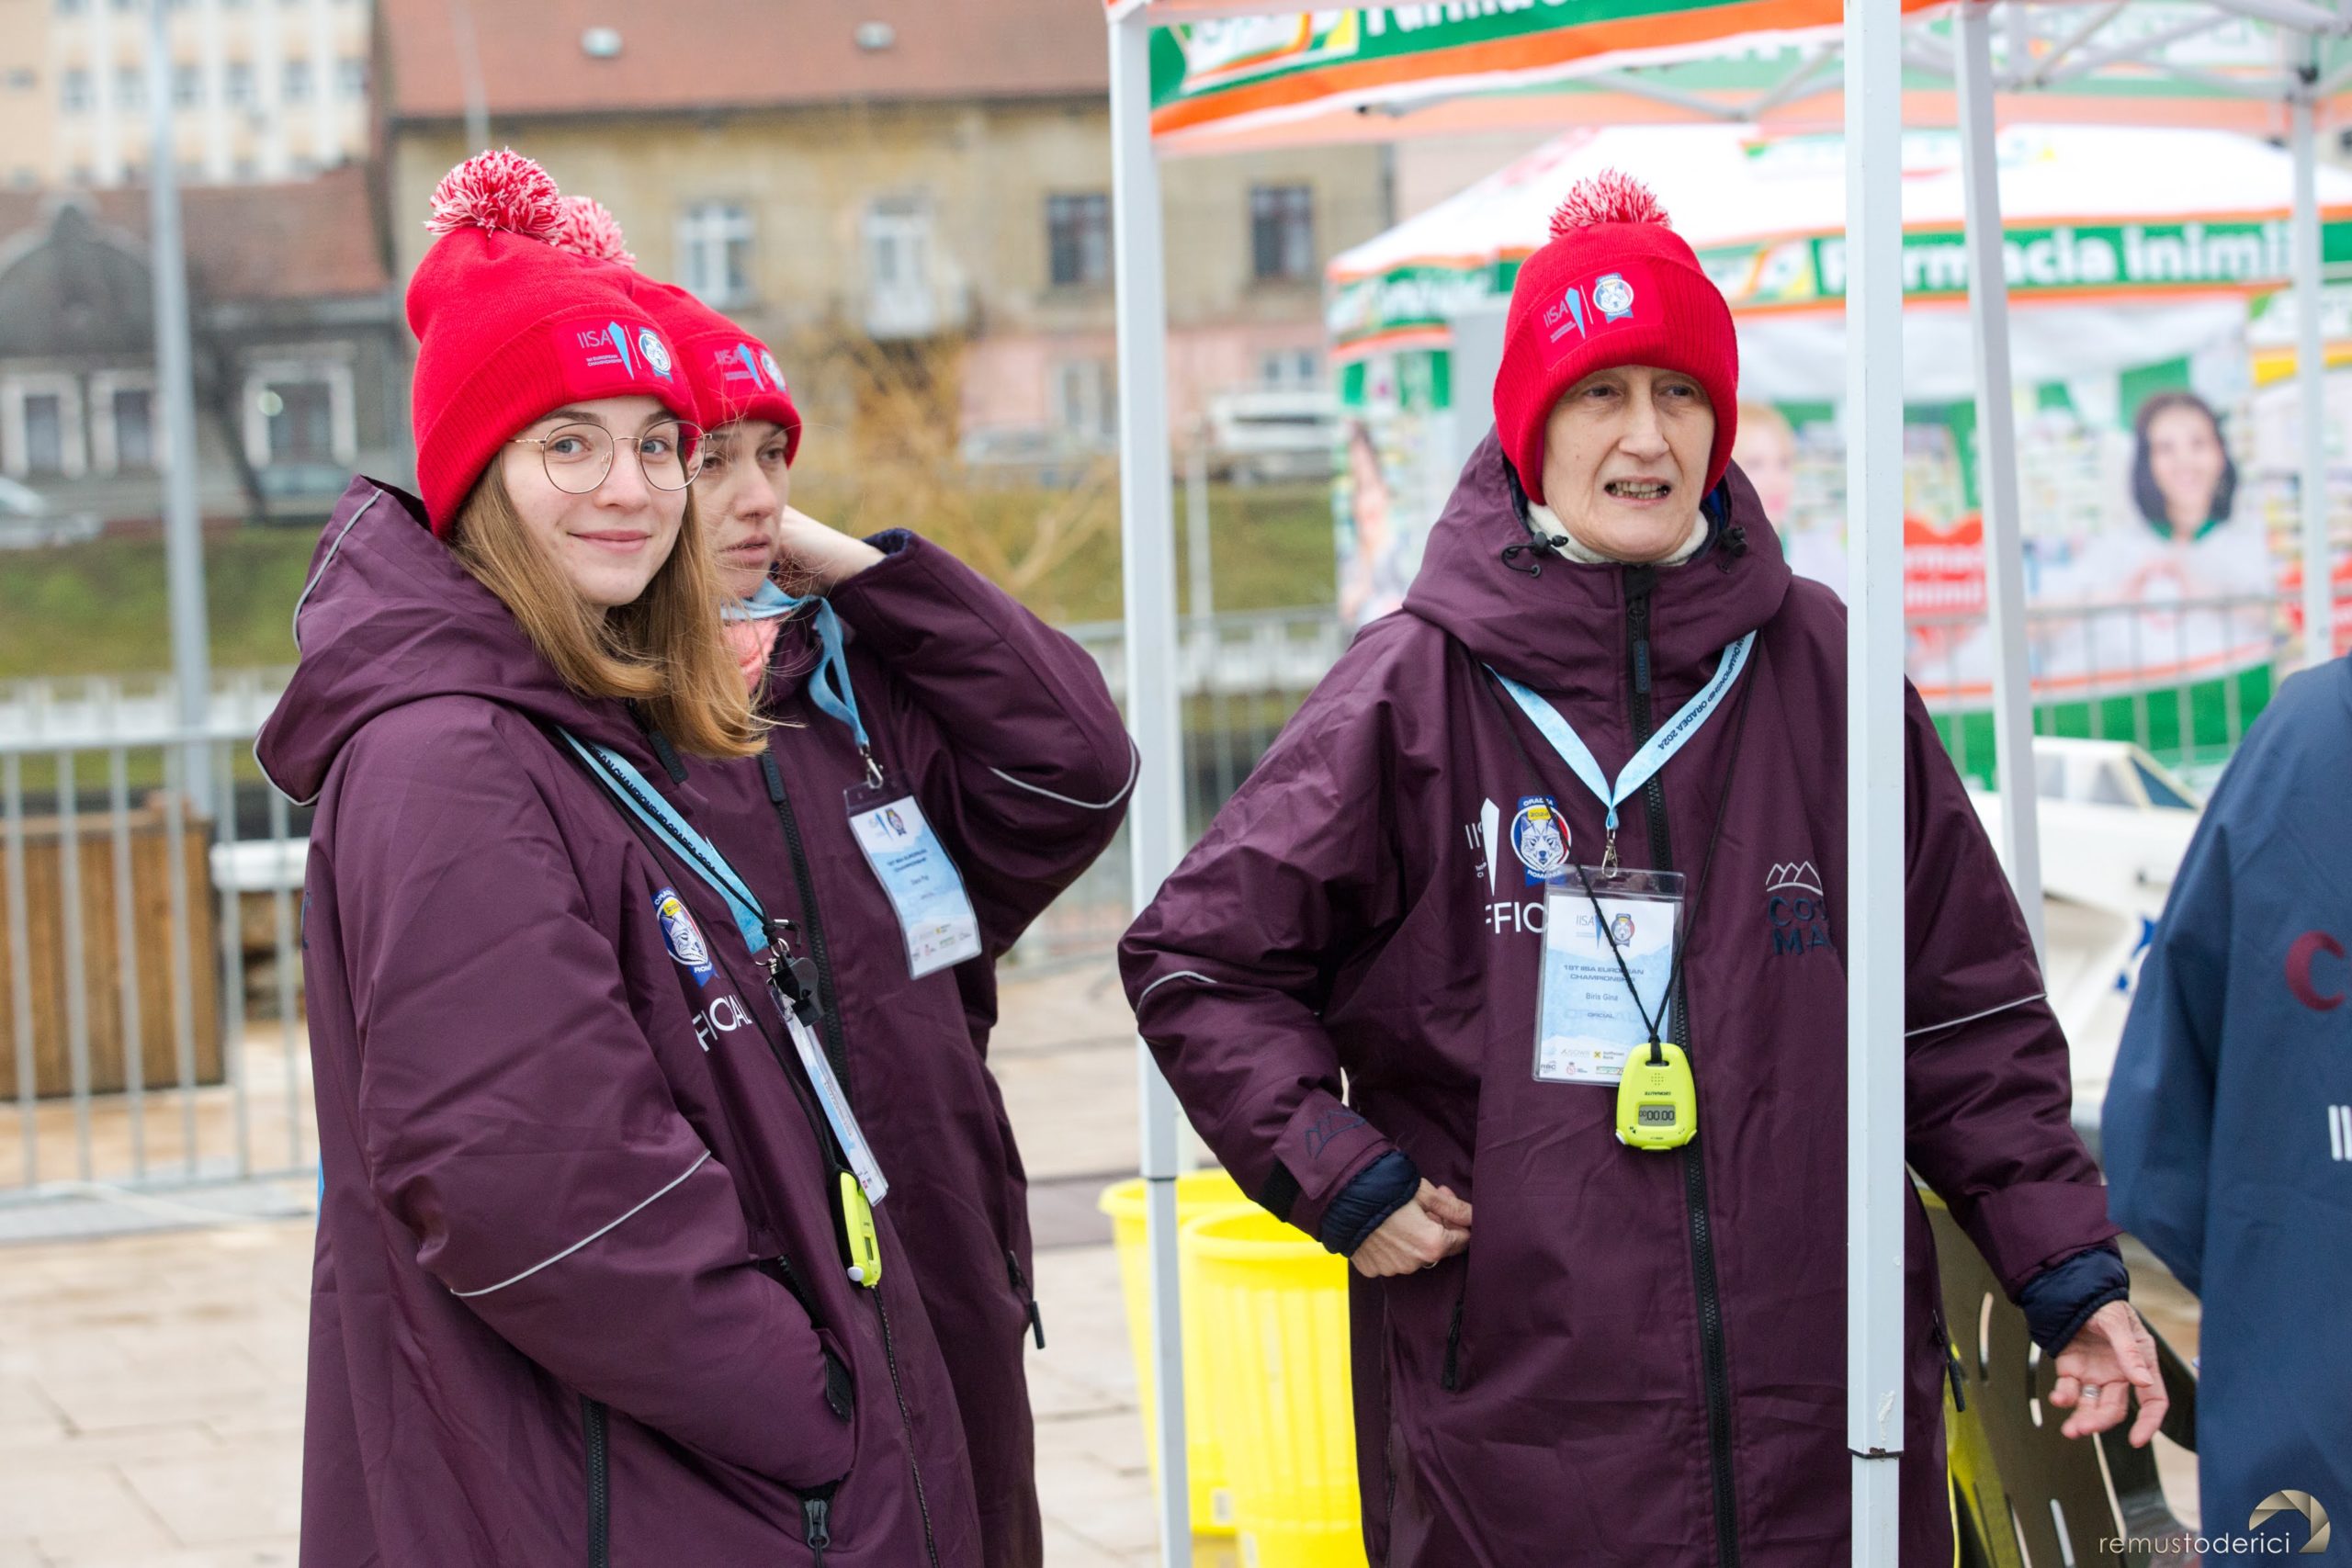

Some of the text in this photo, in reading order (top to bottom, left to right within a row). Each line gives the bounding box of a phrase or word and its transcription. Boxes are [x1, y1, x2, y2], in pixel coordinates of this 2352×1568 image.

[1544, 300, 1569, 328] IISA
[577, 330, 613, 348] IISA
[1677, 701, 1708, 732] ORADEA
[1657, 729, 1678, 750] 2024
[1576, 914, 1595, 927] IISA
